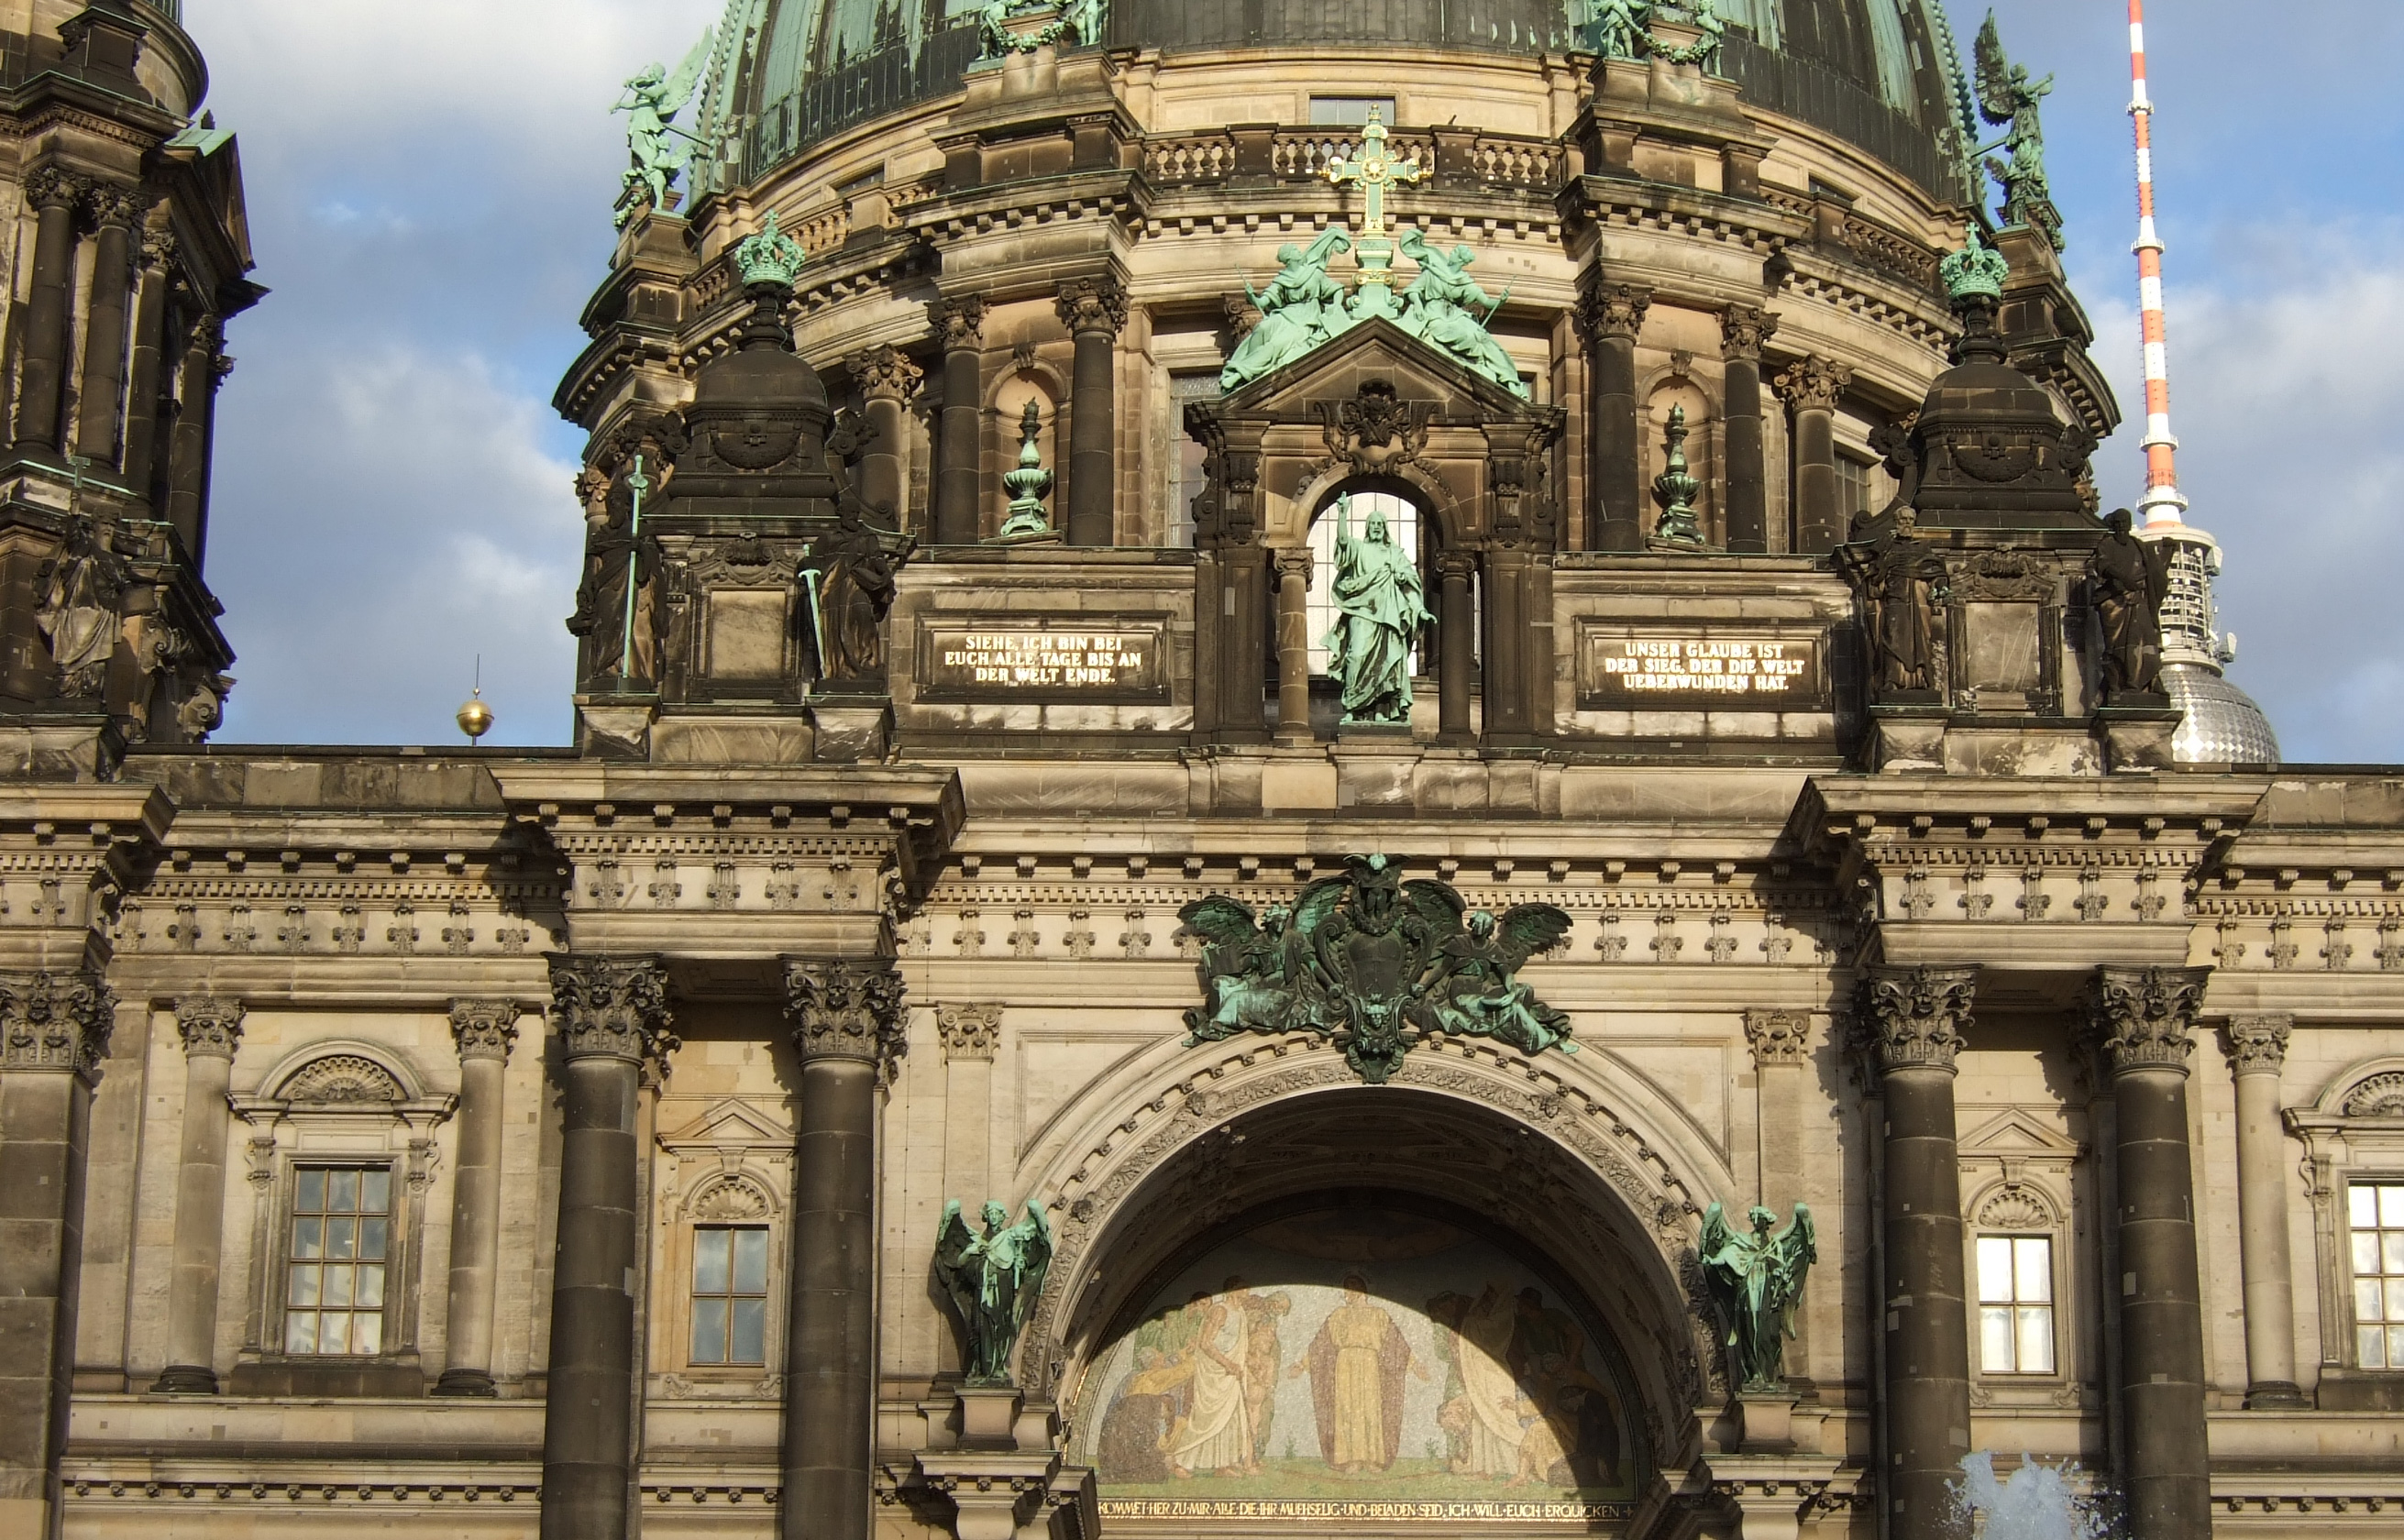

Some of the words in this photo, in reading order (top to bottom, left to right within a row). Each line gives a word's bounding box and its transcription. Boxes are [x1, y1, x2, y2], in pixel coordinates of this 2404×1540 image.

[965, 636, 1020, 652] SIEHE,
[1023, 636, 1053, 650] ICH
[1057, 636, 1087, 650] BIN
[1094, 637, 1122, 651] BEI
[1625, 643, 1681, 658] UNSER
[1686, 644, 1752, 658] GLAUBE
[1757, 644, 1784, 659] IST
[944, 652, 989, 666] EUCH
[995, 652, 1035, 666] ALLE
[1039, 653, 1082, 666] TAGE
[1086, 653, 1114, 666] BIS
[1118, 653, 1141, 666] AN
[1605, 658, 1638, 673] DER
[1644, 659, 1685, 675] SIEG,
[1689, 659, 1723, 674] DER
[1728, 660, 1757, 674] DIE
[1760, 660, 1805, 675] WELT
[975, 668, 1009, 682] DER
[1014, 668, 1060, 682] WELT
[1065, 668, 1116, 683] ENDE.
[1623, 674, 1748, 689] UEBERWUNDEN
[1755, 676, 1790, 690] HAT.
[1097, 1502, 1146, 1514] KOMMET
[1149, 1502, 1171, 1515] HER
[1172, 1502, 1187, 1515] ZU
[1188, 1502, 1210, 1515] MIR
[1212, 1502, 1237, 1515] ALLE
[1240, 1502, 1258, 1515] DIE
[1260, 1502, 1278, 1516] IHR
[1279, 1502, 1340, 1516] MUEHSELIG
[1343, 1503, 1367, 1516] UND
[1449, 1503, 1470, 1517] ICH
[1473, 1503, 1503, 1517] WILL
[1506, 1504, 1540, 1517] EUCH
[1545, 1504, 1619, 1517] ERQUICKEN
